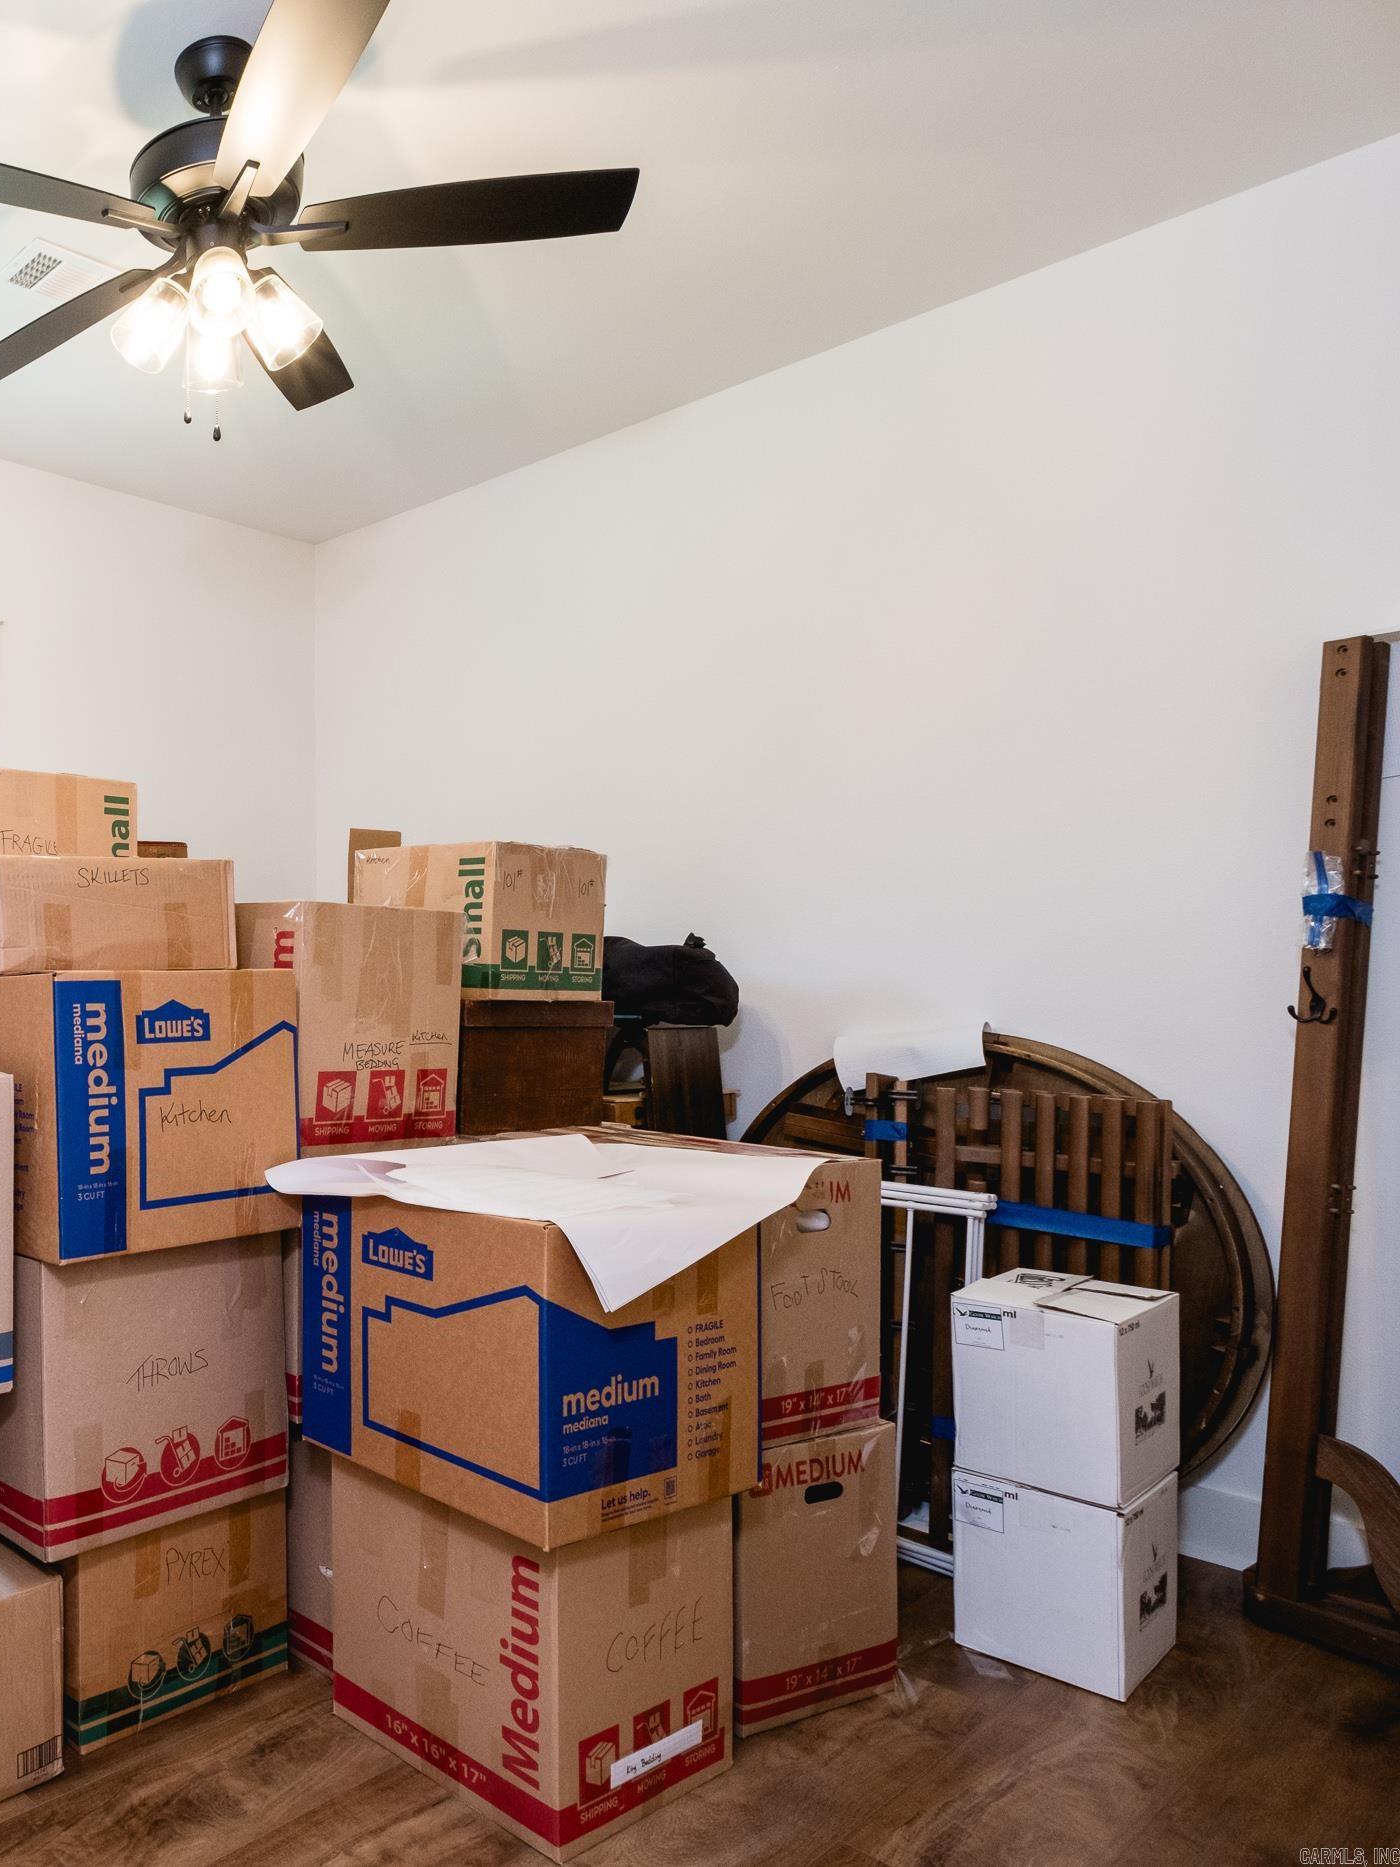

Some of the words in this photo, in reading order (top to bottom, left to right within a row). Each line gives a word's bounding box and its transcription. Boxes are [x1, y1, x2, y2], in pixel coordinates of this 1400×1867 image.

[76, 867, 150, 889] SKILLETS
[501, 973, 526, 983] SHIPPING
[72, 1003, 85, 1065] mediana
[143, 1015, 204, 1039] LOWE'S
[85, 1002, 118, 1176] medium
[159, 1099, 232, 1132] Kitchen
[413, 1120, 443, 1130] STORING
[314, 1125, 350, 1137] SHIPPING
[368, 1122, 397, 1133] MOVING
[77, 1193, 83, 1201] 3
[83, 1192, 95, 1201] CU
[96, 1191, 105, 1199] FT
[313, 1211, 322, 1267] mediana
[368, 1238, 426, 1274] LOWE'S
[322, 1212, 345, 1374] medium
[1002, 1310, 1017, 1319] ml
[695, 1320, 724, 1334] FRAGILE
[695, 1335, 725, 1348] Bedroom
[695, 1349, 717, 1361] Family
[718, 1346, 737, 1356] Room
[125, 1348, 209, 1393] THROWS
[695, 1364, 717, 1376] Dining
[718, 1360, 737, 1371] Room
[562, 1373, 660, 1417] medium
[695, 1377, 721, 1390] Kitchen
[695, 1391, 712, 1403] Bath
[695, 1402, 729, 1417] Basement
[562, 1415, 609, 1435] mediana
[562, 1458, 567, 1467] 3
[567, 1456, 578, 1466] CU
[579, 1453, 588, 1463] FT
[775, 1449, 865, 1490] MEDIUM
[601, 1497, 616, 1510] Let
[617, 1495, 628, 1505] us
[629, 1488, 651, 1502] help.
[1004, 1491, 1018, 1501] ml
[165, 1547, 226, 1584] PYREX
[377, 1594, 490, 1687] COFFEE
[606, 1595, 704, 1673] COFFEE
[500, 1555, 541, 1791] Medium
[409, 1734, 418, 1746] x
[448, 1757, 457, 1770] x
[684, 1743, 716, 1767] STORING
[637, 1769, 667, 1793] MOVING
[579, 1796, 619, 1824] SHIPPING
